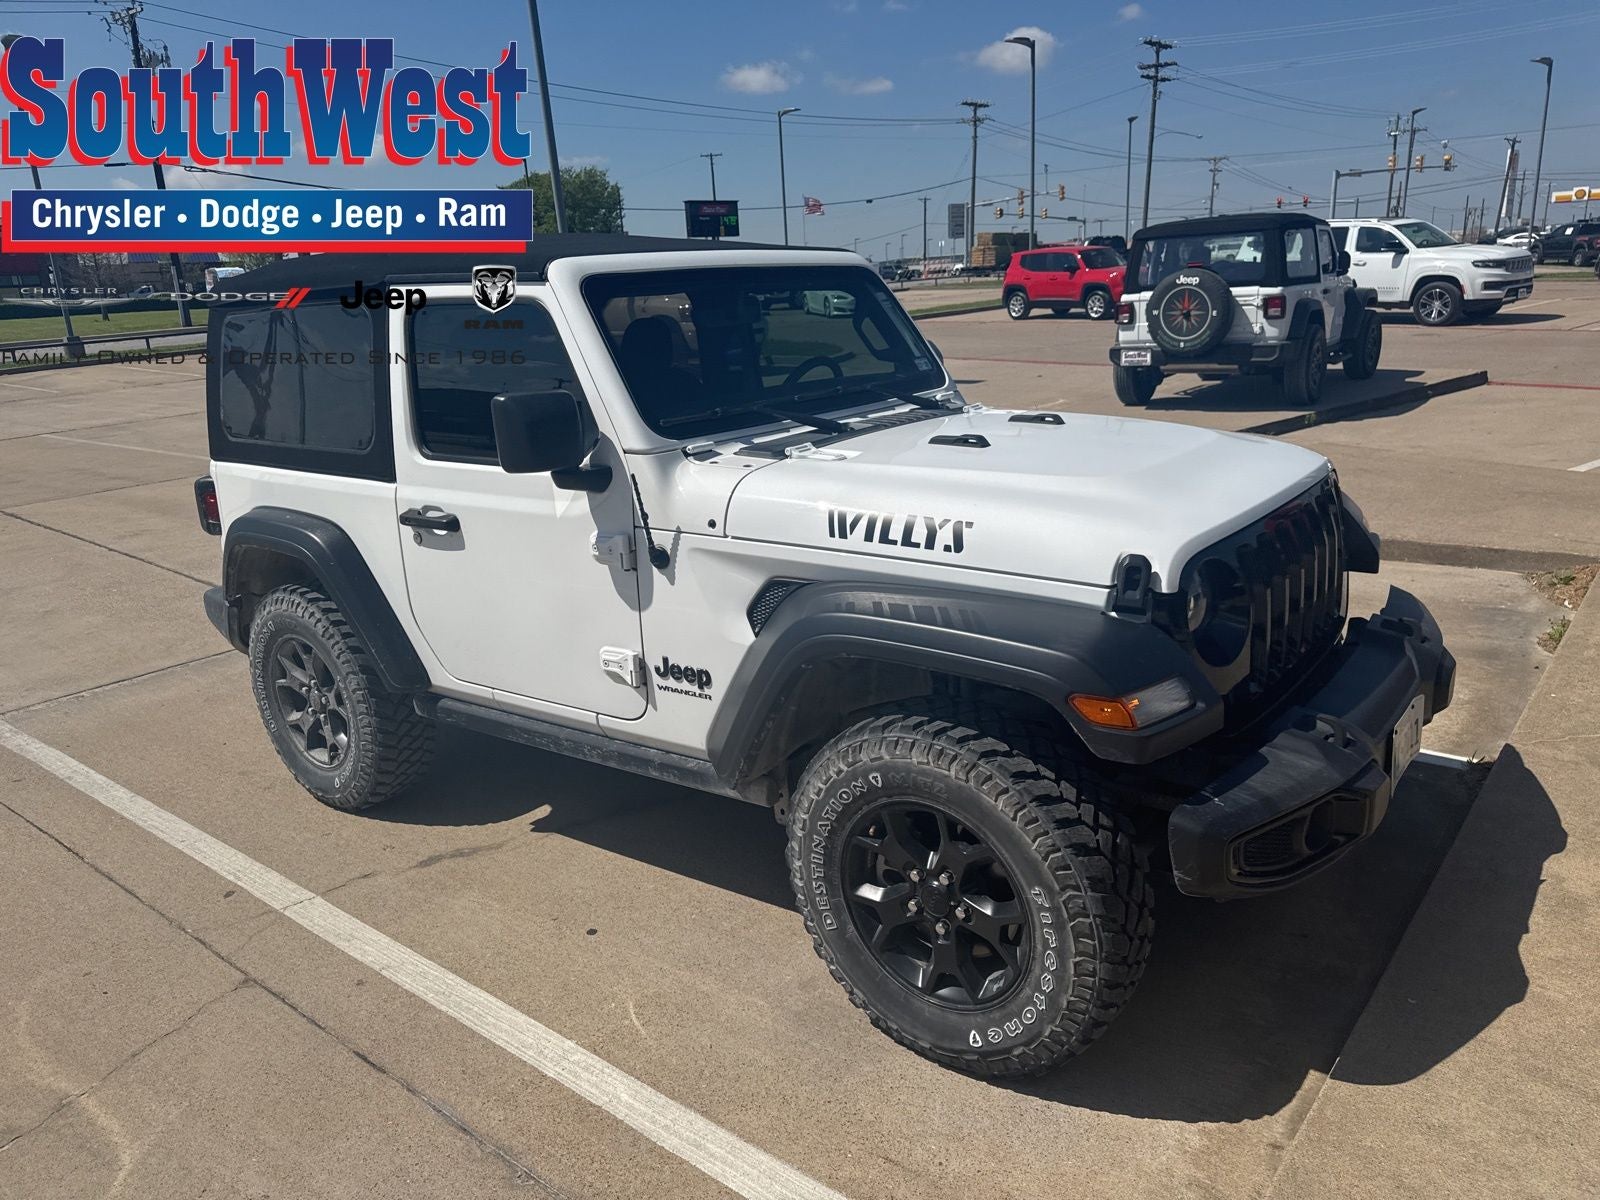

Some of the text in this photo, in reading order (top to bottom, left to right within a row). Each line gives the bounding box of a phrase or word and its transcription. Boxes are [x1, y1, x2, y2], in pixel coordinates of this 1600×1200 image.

[1175, 274, 1200, 286] Jeep
[1212, 309, 1218, 317] E
[828, 508, 975, 554] WILLYS
[654, 655, 712, 690] Jeep
[656, 683, 713, 701] WRANGLER
[810, 777, 869, 932] DESTINATION
[987, 887, 1059, 1044] Firestone
